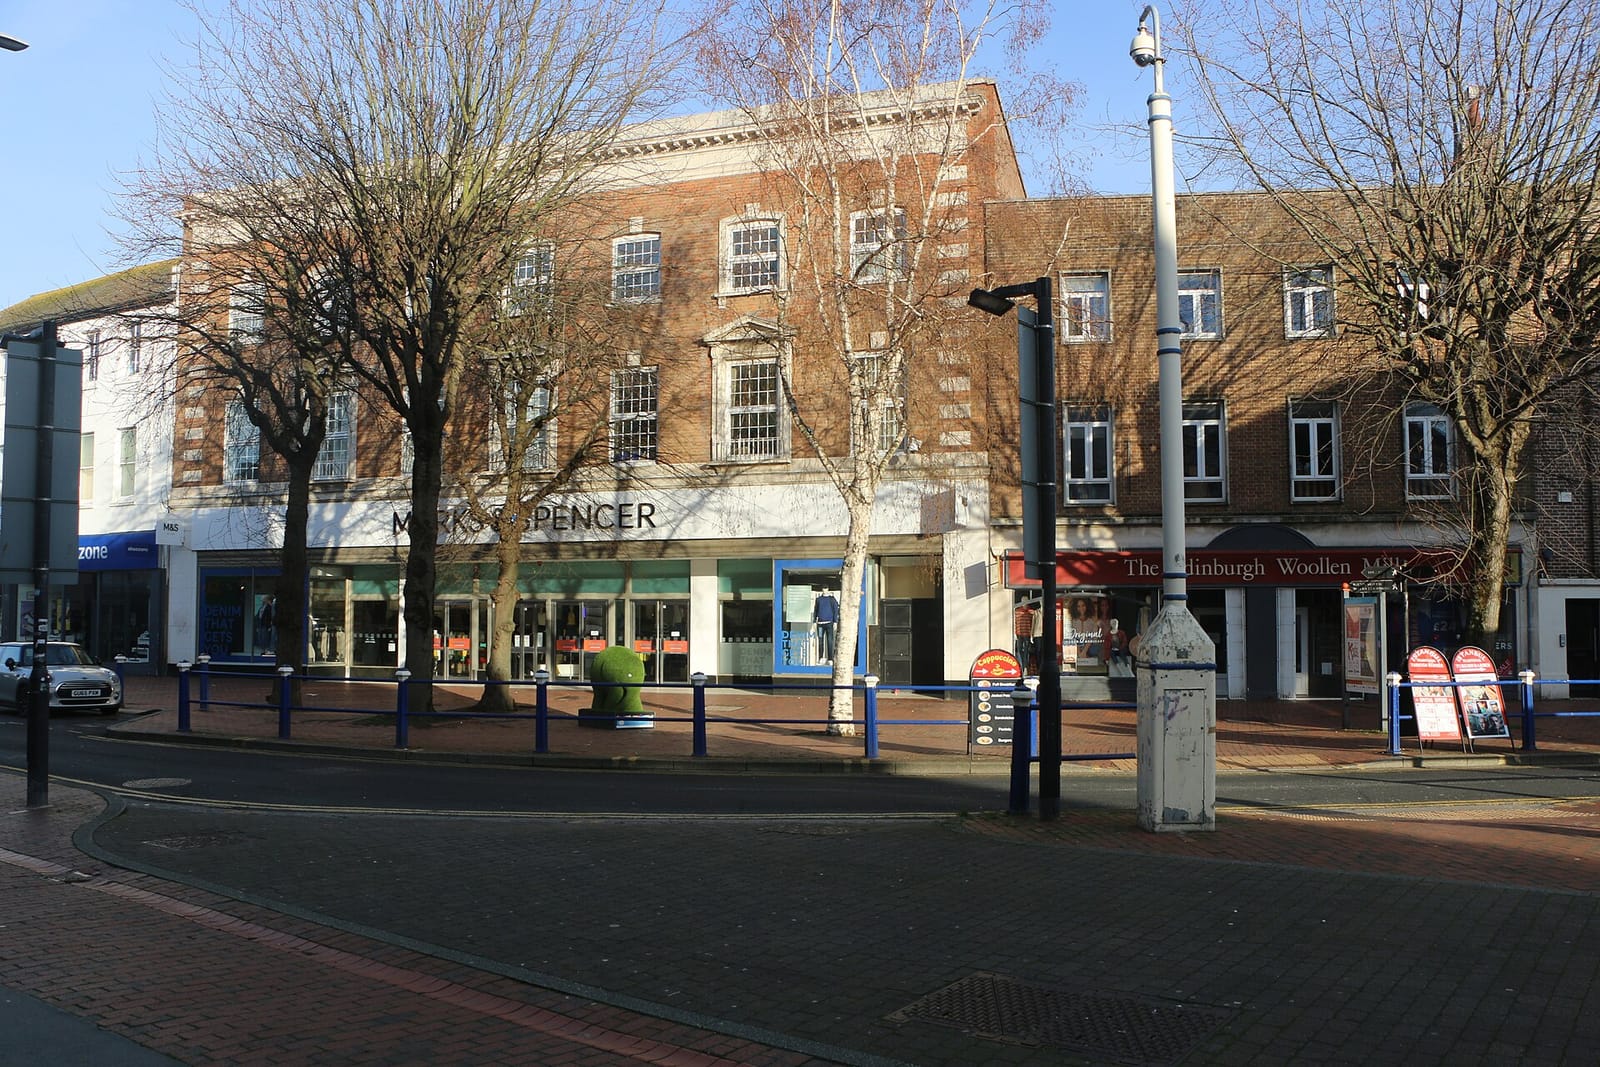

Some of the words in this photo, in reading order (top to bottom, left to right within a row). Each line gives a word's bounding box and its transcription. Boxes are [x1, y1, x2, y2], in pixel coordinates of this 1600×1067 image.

[163, 523, 179, 532] M&S
[1124, 558, 1159, 577] The
[1185, 557, 1265, 581] dinburgh
[1276, 557, 1352, 576] Woollen
[977, 654, 1017, 667] Cappuccino
